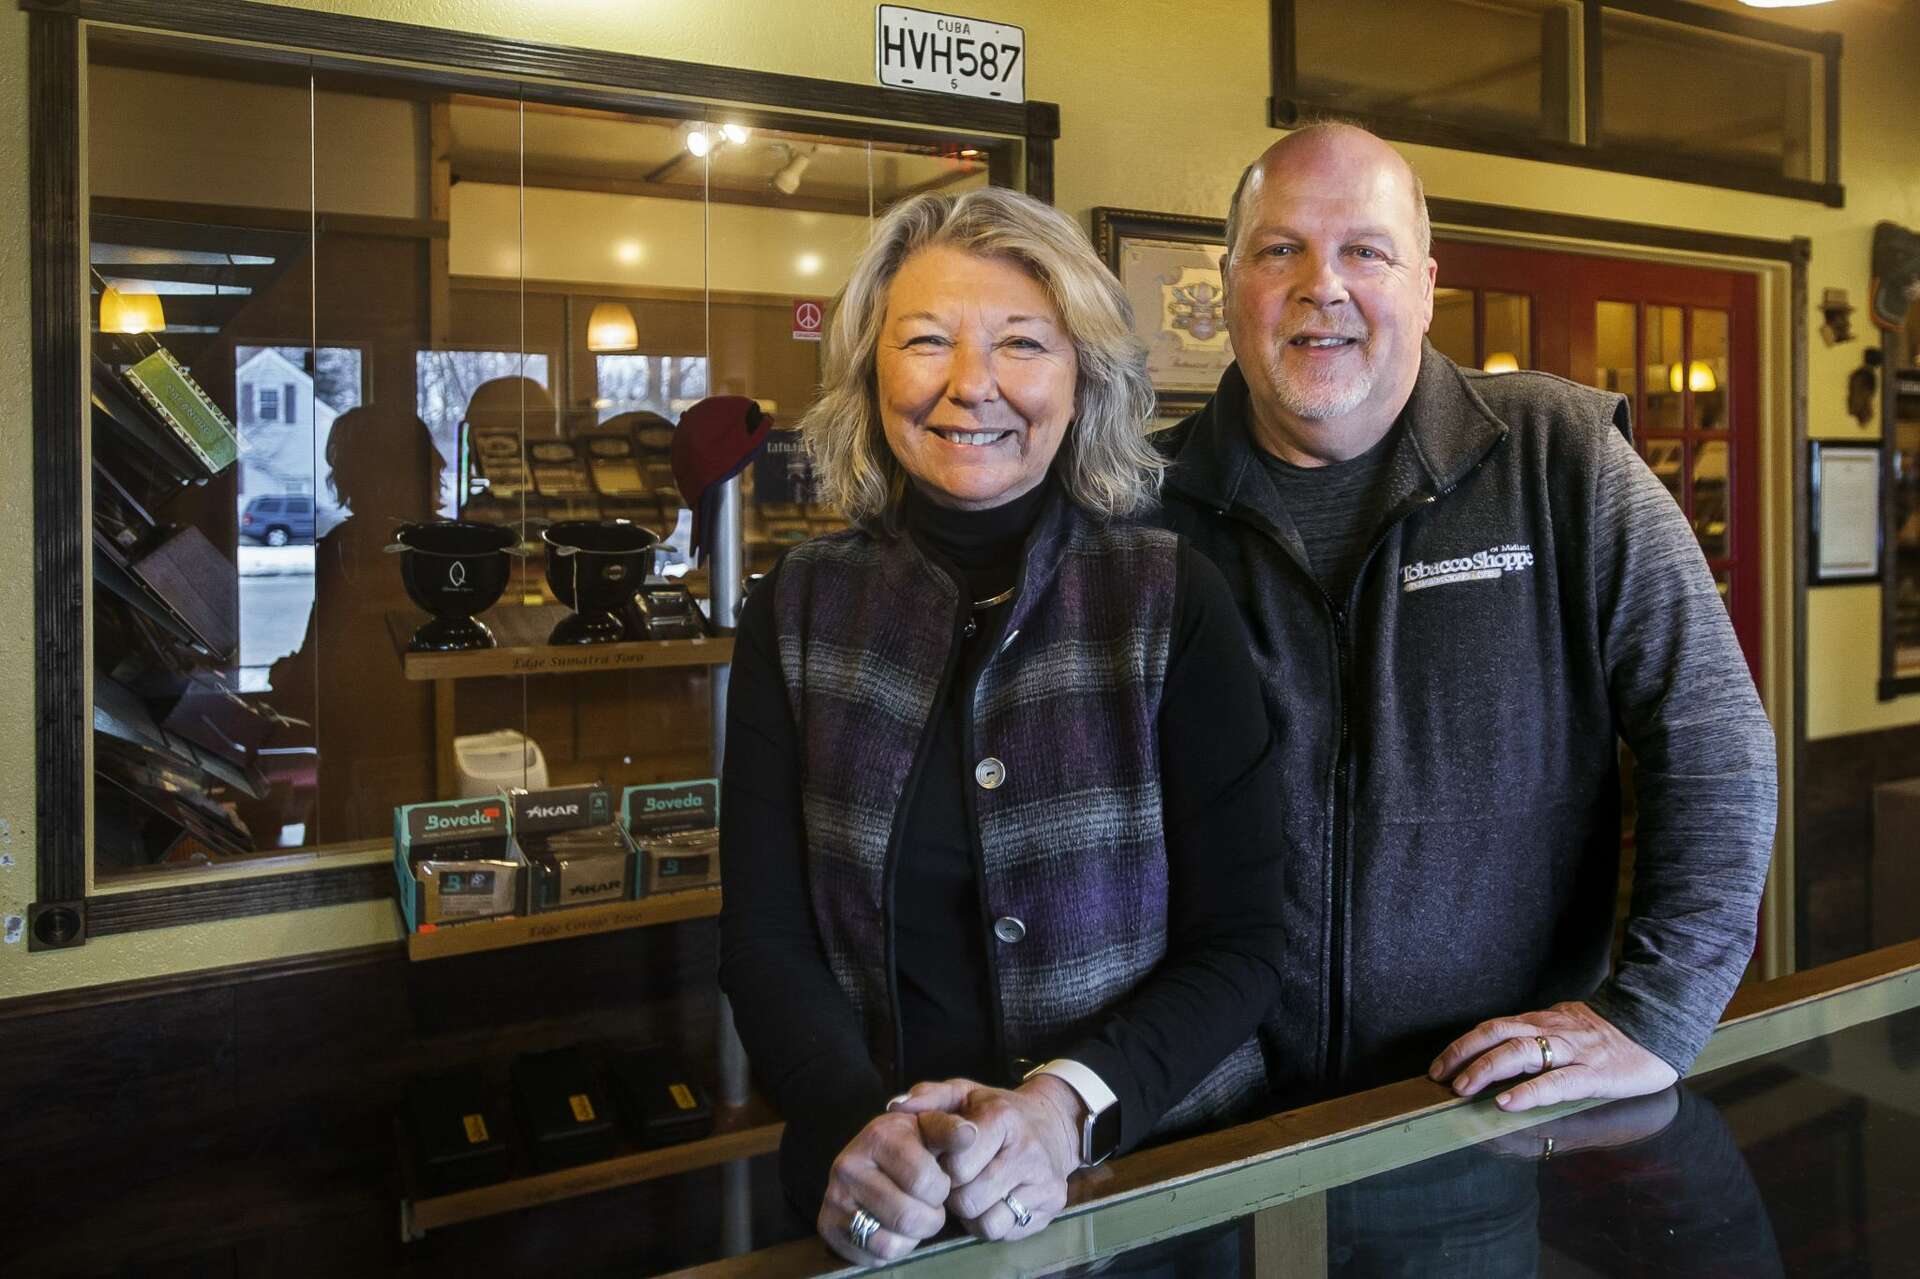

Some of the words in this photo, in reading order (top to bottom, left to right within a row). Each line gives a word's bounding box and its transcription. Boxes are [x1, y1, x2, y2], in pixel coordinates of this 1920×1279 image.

[937, 19, 971, 35] CUBA
[883, 25, 1021, 82] HVH587
[643, 793, 703, 811] Boveda
[424, 809, 492, 831] Boveda
